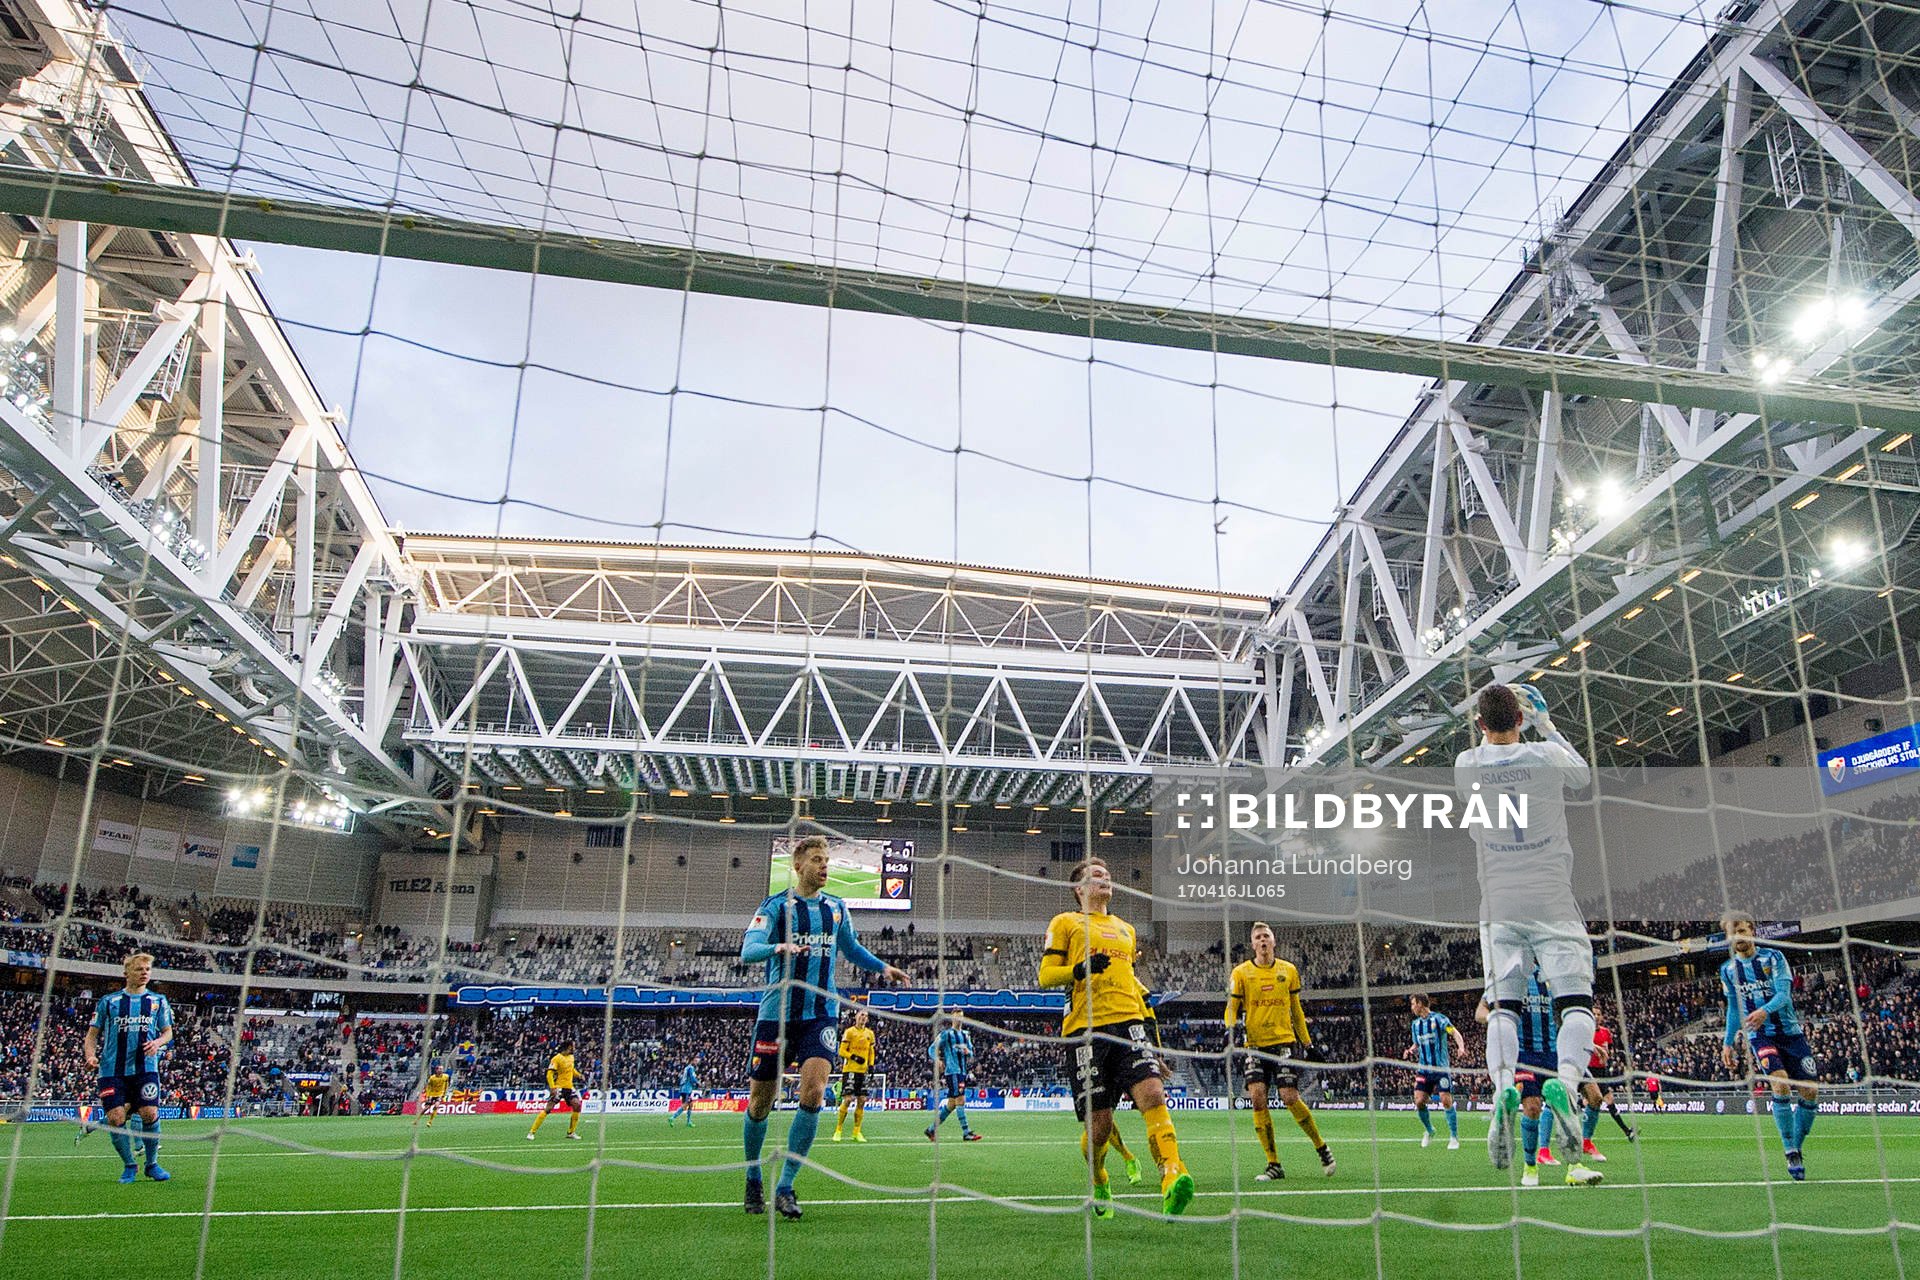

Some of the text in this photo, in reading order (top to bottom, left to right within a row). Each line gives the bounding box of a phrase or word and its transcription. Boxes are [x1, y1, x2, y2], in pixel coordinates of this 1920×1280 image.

[1851, 741, 1911, 766] DJURGÅRDENS IF
[1853, 754, 1899, 775] STOCKHOLMS
[1481, 768, 1532, 785] ISAKSSON
[389, 878, 432, 893] TELE2
[611, 1100, 668, 1108] WANGESKOG
[888, 1100, 922, 1110] Finans
[1817, 1101, 1839, 1112] stolt
[1840, 1103, 1876, 1114] partner
[1876, 1101, 1908, 1113] sedan
